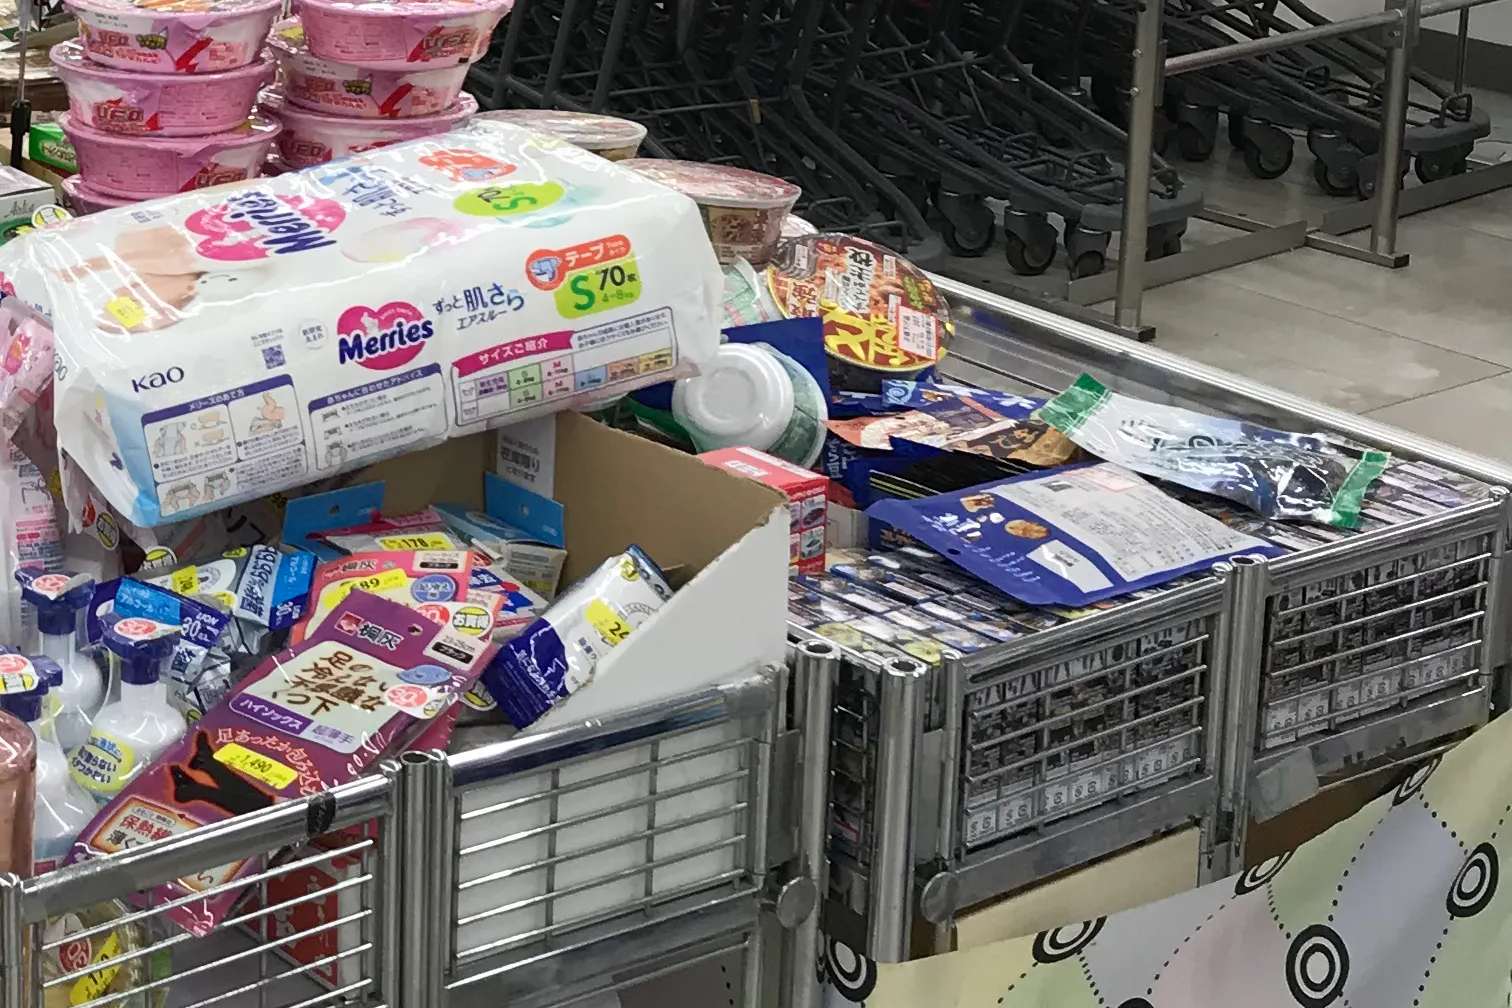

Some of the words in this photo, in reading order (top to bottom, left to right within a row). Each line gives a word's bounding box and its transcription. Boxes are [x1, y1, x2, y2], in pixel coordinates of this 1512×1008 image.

[564, 242, 605, 268] テープ
[570, 274, 597, 311] S
[456, 308, 508, 331] エアスルー
[338, 317, 434, 365] Merries
[478, 338, 549, 365] サイズご紹介
[196, 612, 220, 625] LION
[357, 621, 405, 651] 桐灰
[324, 650, 374, 674] 足の
[303, 661, 389, 694] 冷えない
[287, 676, 386, 715] 不思議な
[239, 696, 304, 730] ハイソックス
